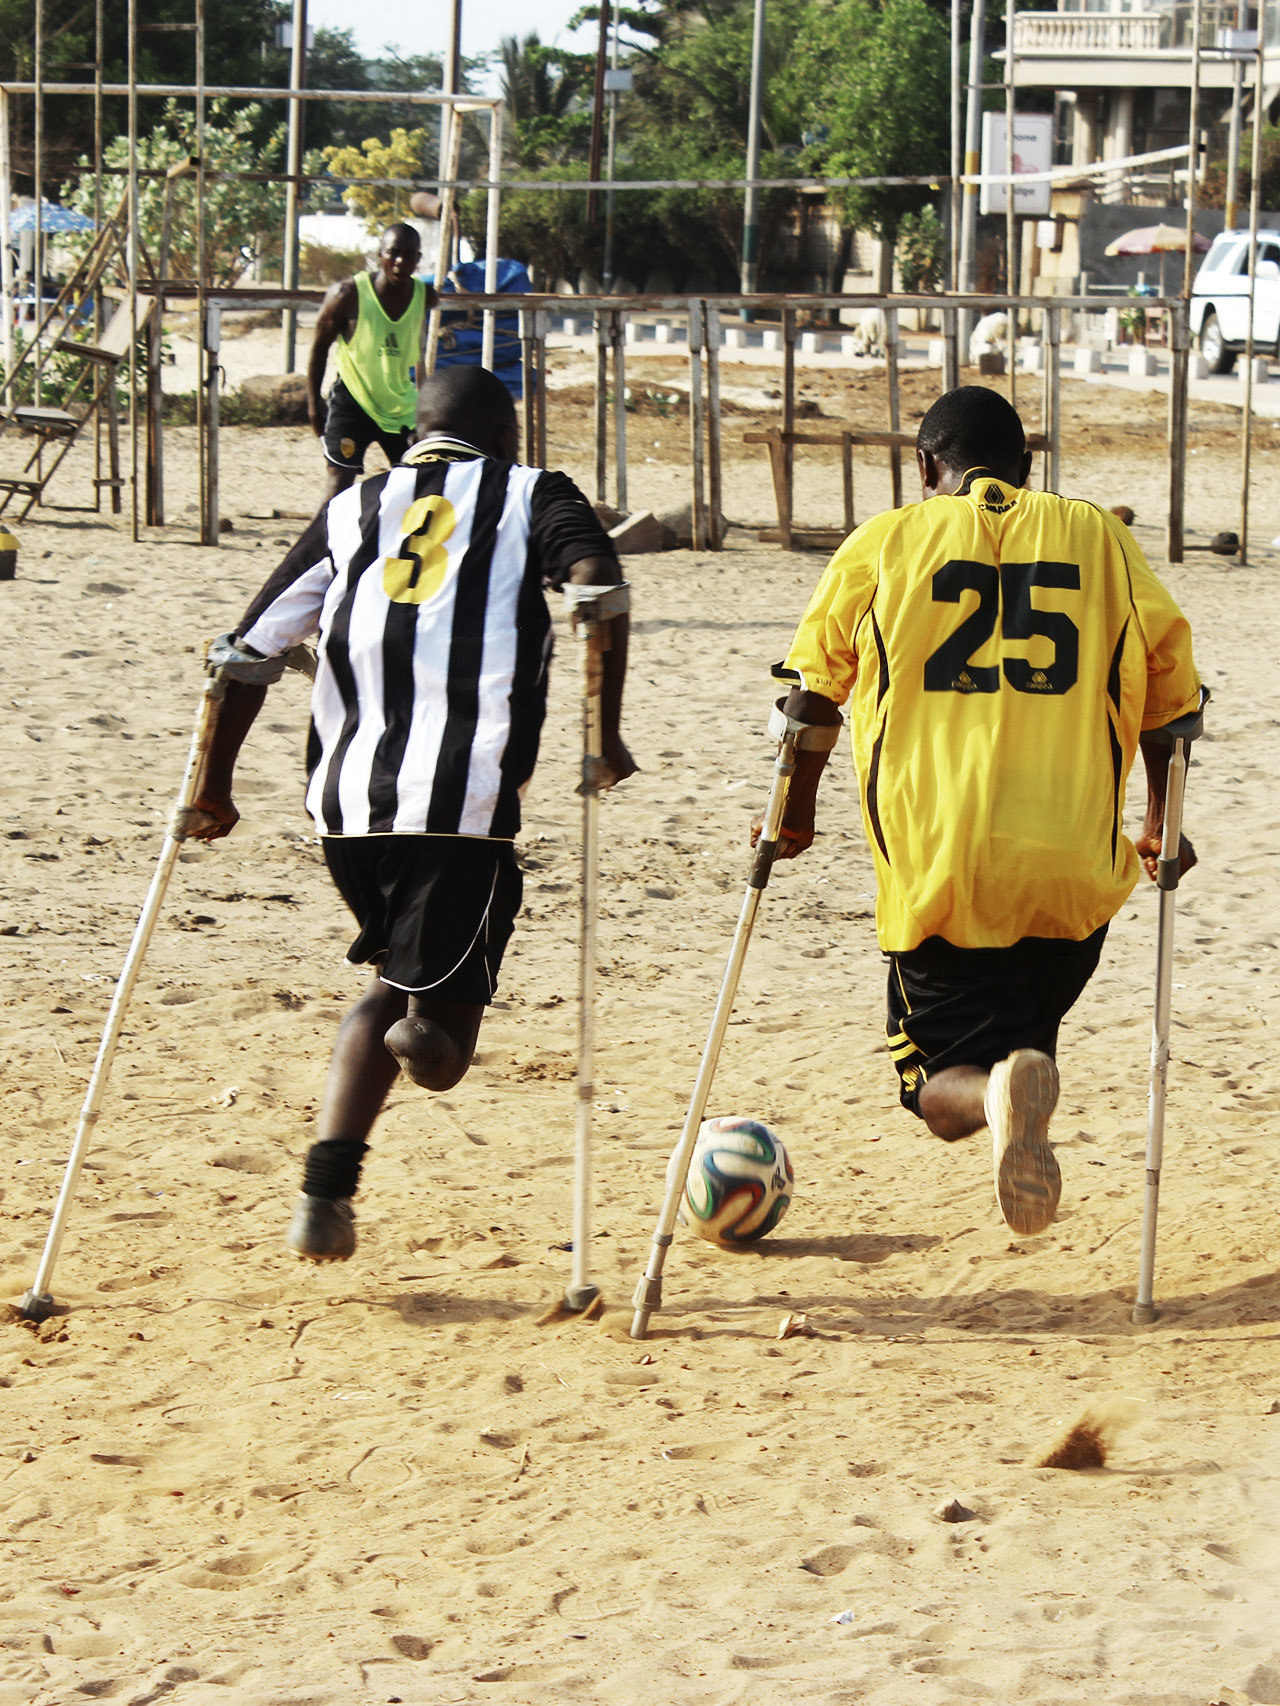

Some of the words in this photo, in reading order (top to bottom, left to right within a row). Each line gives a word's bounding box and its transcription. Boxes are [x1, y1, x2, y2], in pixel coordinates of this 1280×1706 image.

[1002, 186, 1035, 197] Ldge
[382, 494, 456, 605] 3
[924, 560, 1081, 695] 25
